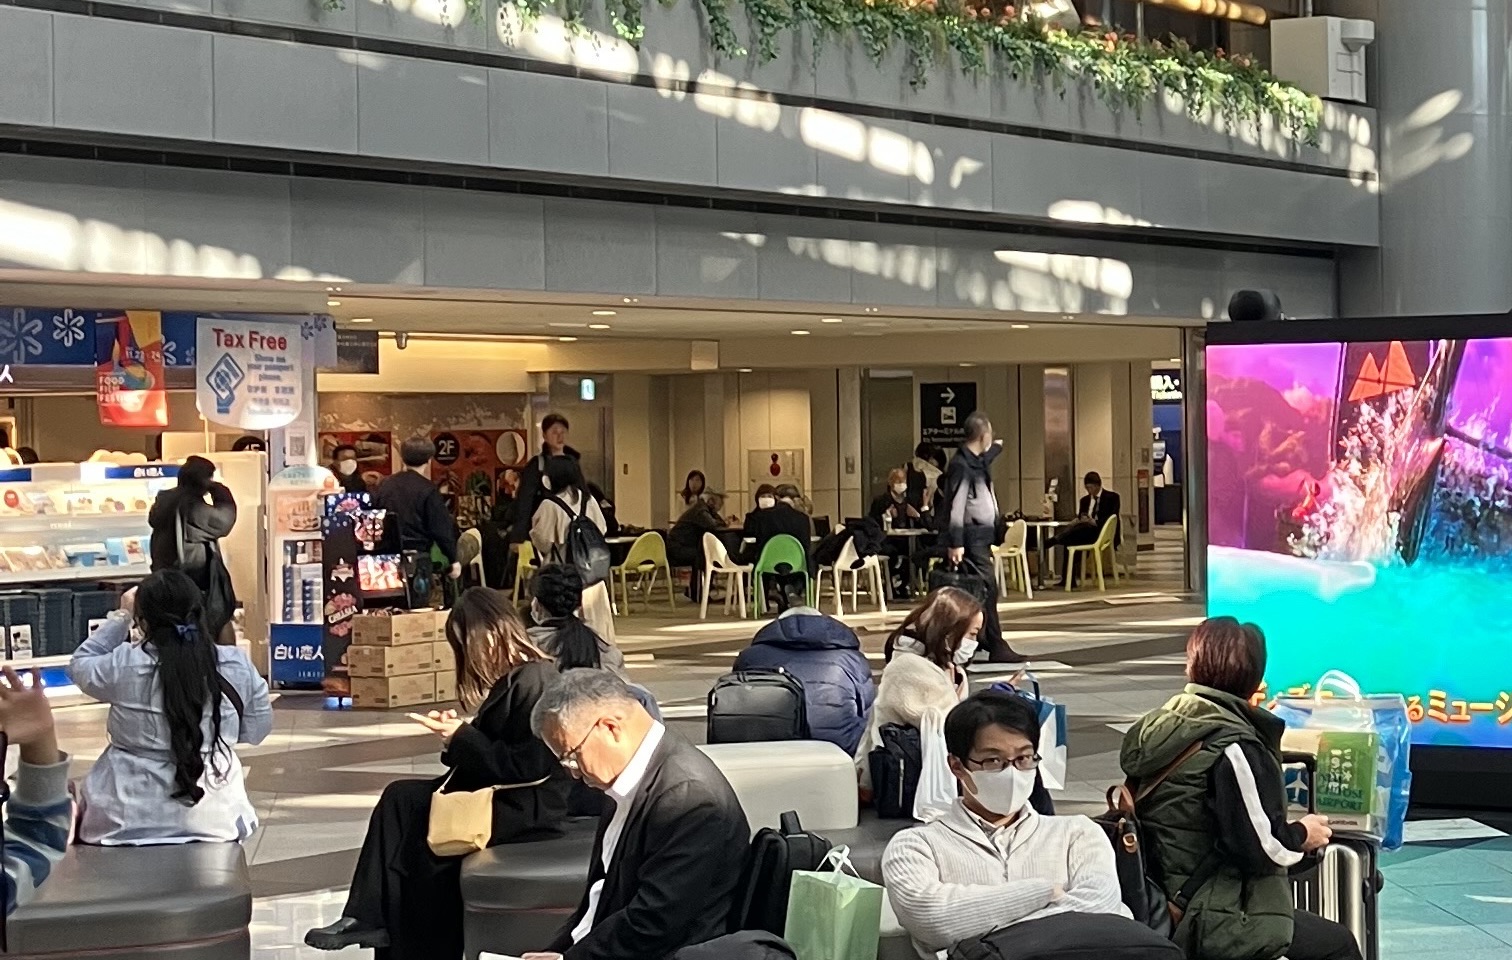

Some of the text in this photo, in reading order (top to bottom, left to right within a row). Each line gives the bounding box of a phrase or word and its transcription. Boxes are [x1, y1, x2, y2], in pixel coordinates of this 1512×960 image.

[212, 328, 287, 350] Tax Free
[438, 439, 455, 455] 2F
[274, 643, 325, 661] 白い恋人
